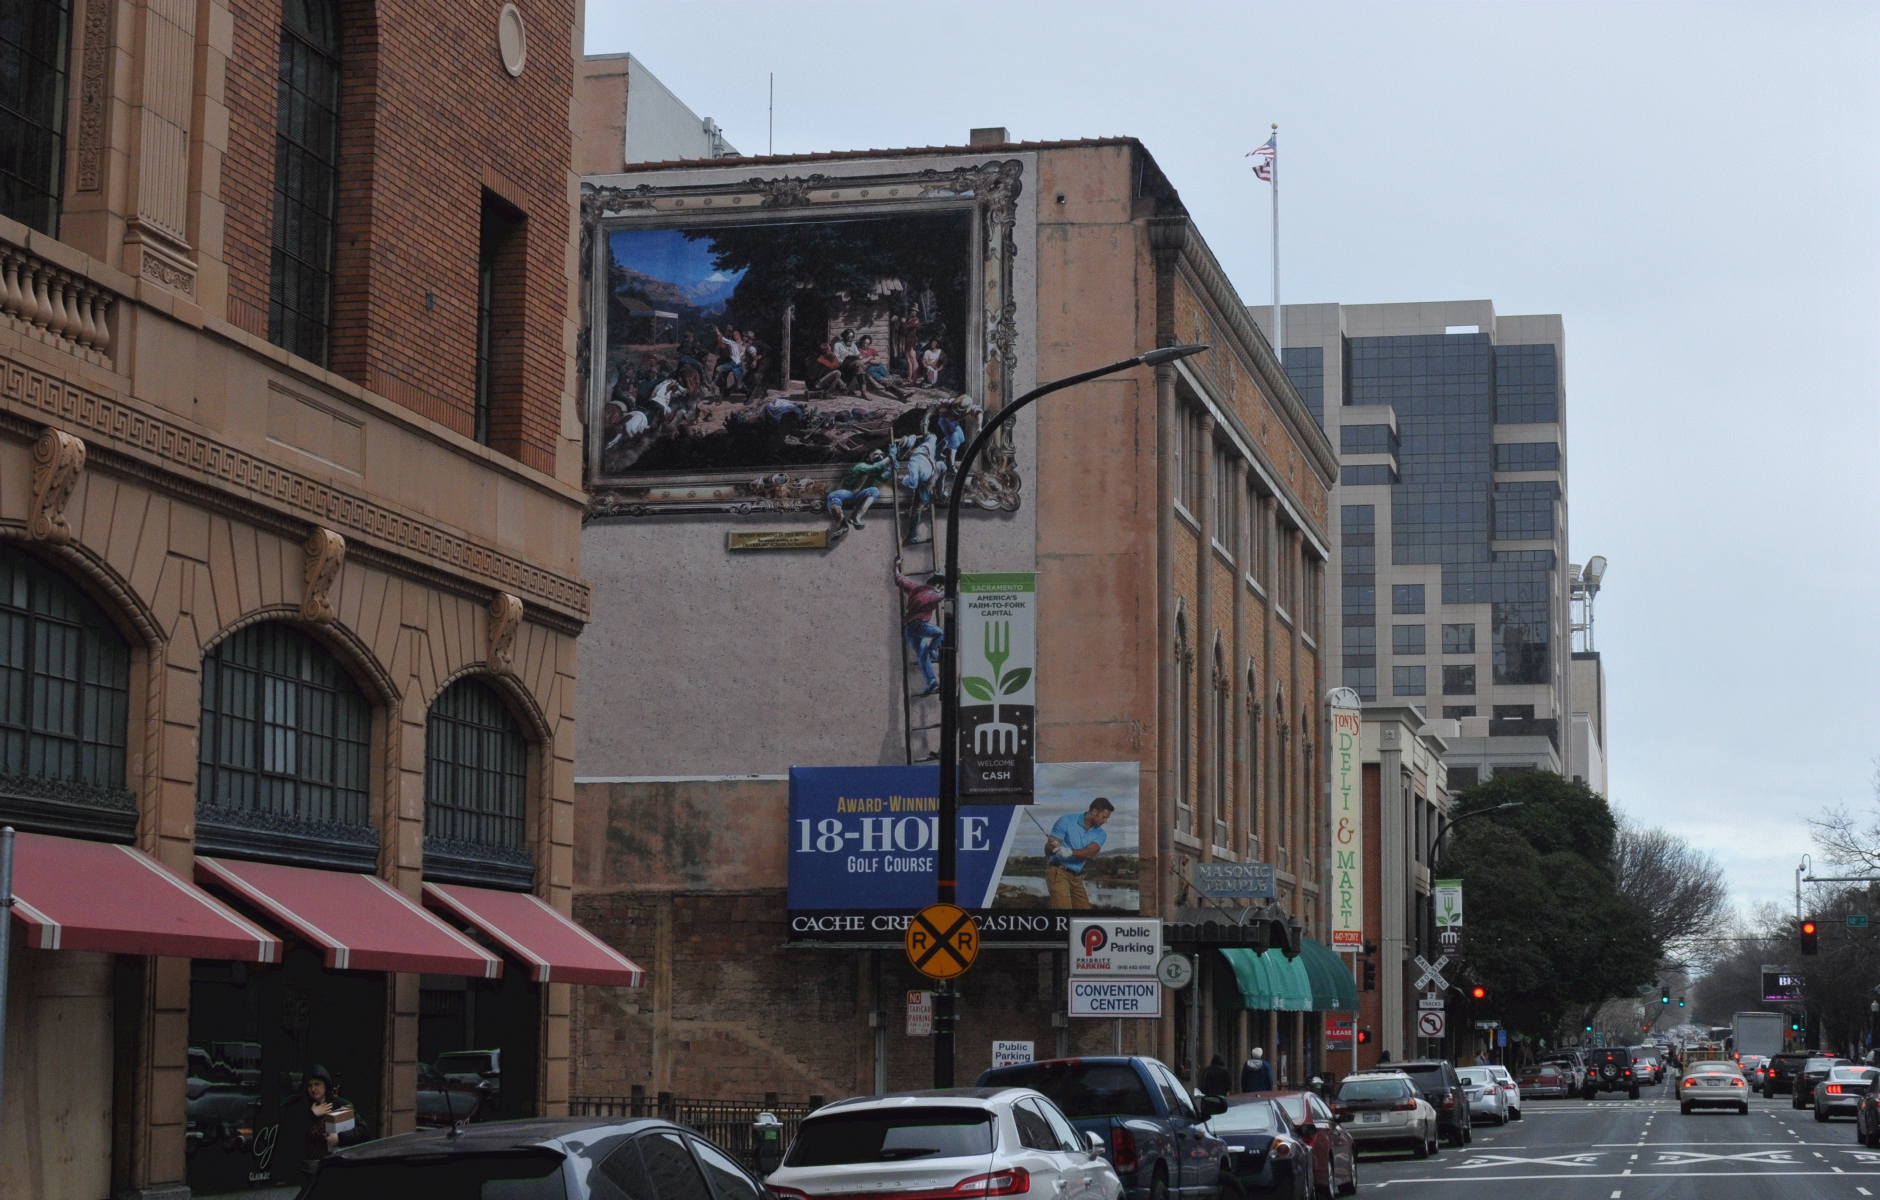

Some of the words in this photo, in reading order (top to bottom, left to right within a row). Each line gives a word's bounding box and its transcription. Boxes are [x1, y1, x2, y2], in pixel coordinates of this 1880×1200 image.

[971, 584, 1024, 592] SACRAMENTO
[1333, 713, 1359, 736] TONY'S
[982, 771, 1011, 780] CASH
[1339, 732, 1353, 811] DELI
[837, 796, 940, 813] AWARD-WINNIN
[1337, 817, 1355, 844] &
[847, 856, 879, 873] GOLF
[884, 855, 933, 872] COURSE
[1200, 866, 1271, 878] MASONIC
[1203, 879, 1267, 892] TEMPLE
[1337, 850, 1356, 929] MART
[792, 915, 865, 931] CACHE
[871, 915, 912, 931] CRE
[971, 915, 1049, 931] CASINO
[1115, 927, 1151, 937] Public
[912, 932, 927, 949] R
[958, 933, 973, 950] R
[1110, 943, 1155, 955] Parking
[1075, 984, 1154, 997] CONVENTION
[909, 993, 921, 1003] NO
[1090, 998, 1139, 1011] CENTER
[909, 1014, 931, 1022] PARKING
[998, 1042, 1028, 1051] Public
[995, 1051, 1031, 1063] Parking
[824, 1178, 938, 1191] LINCOLN
